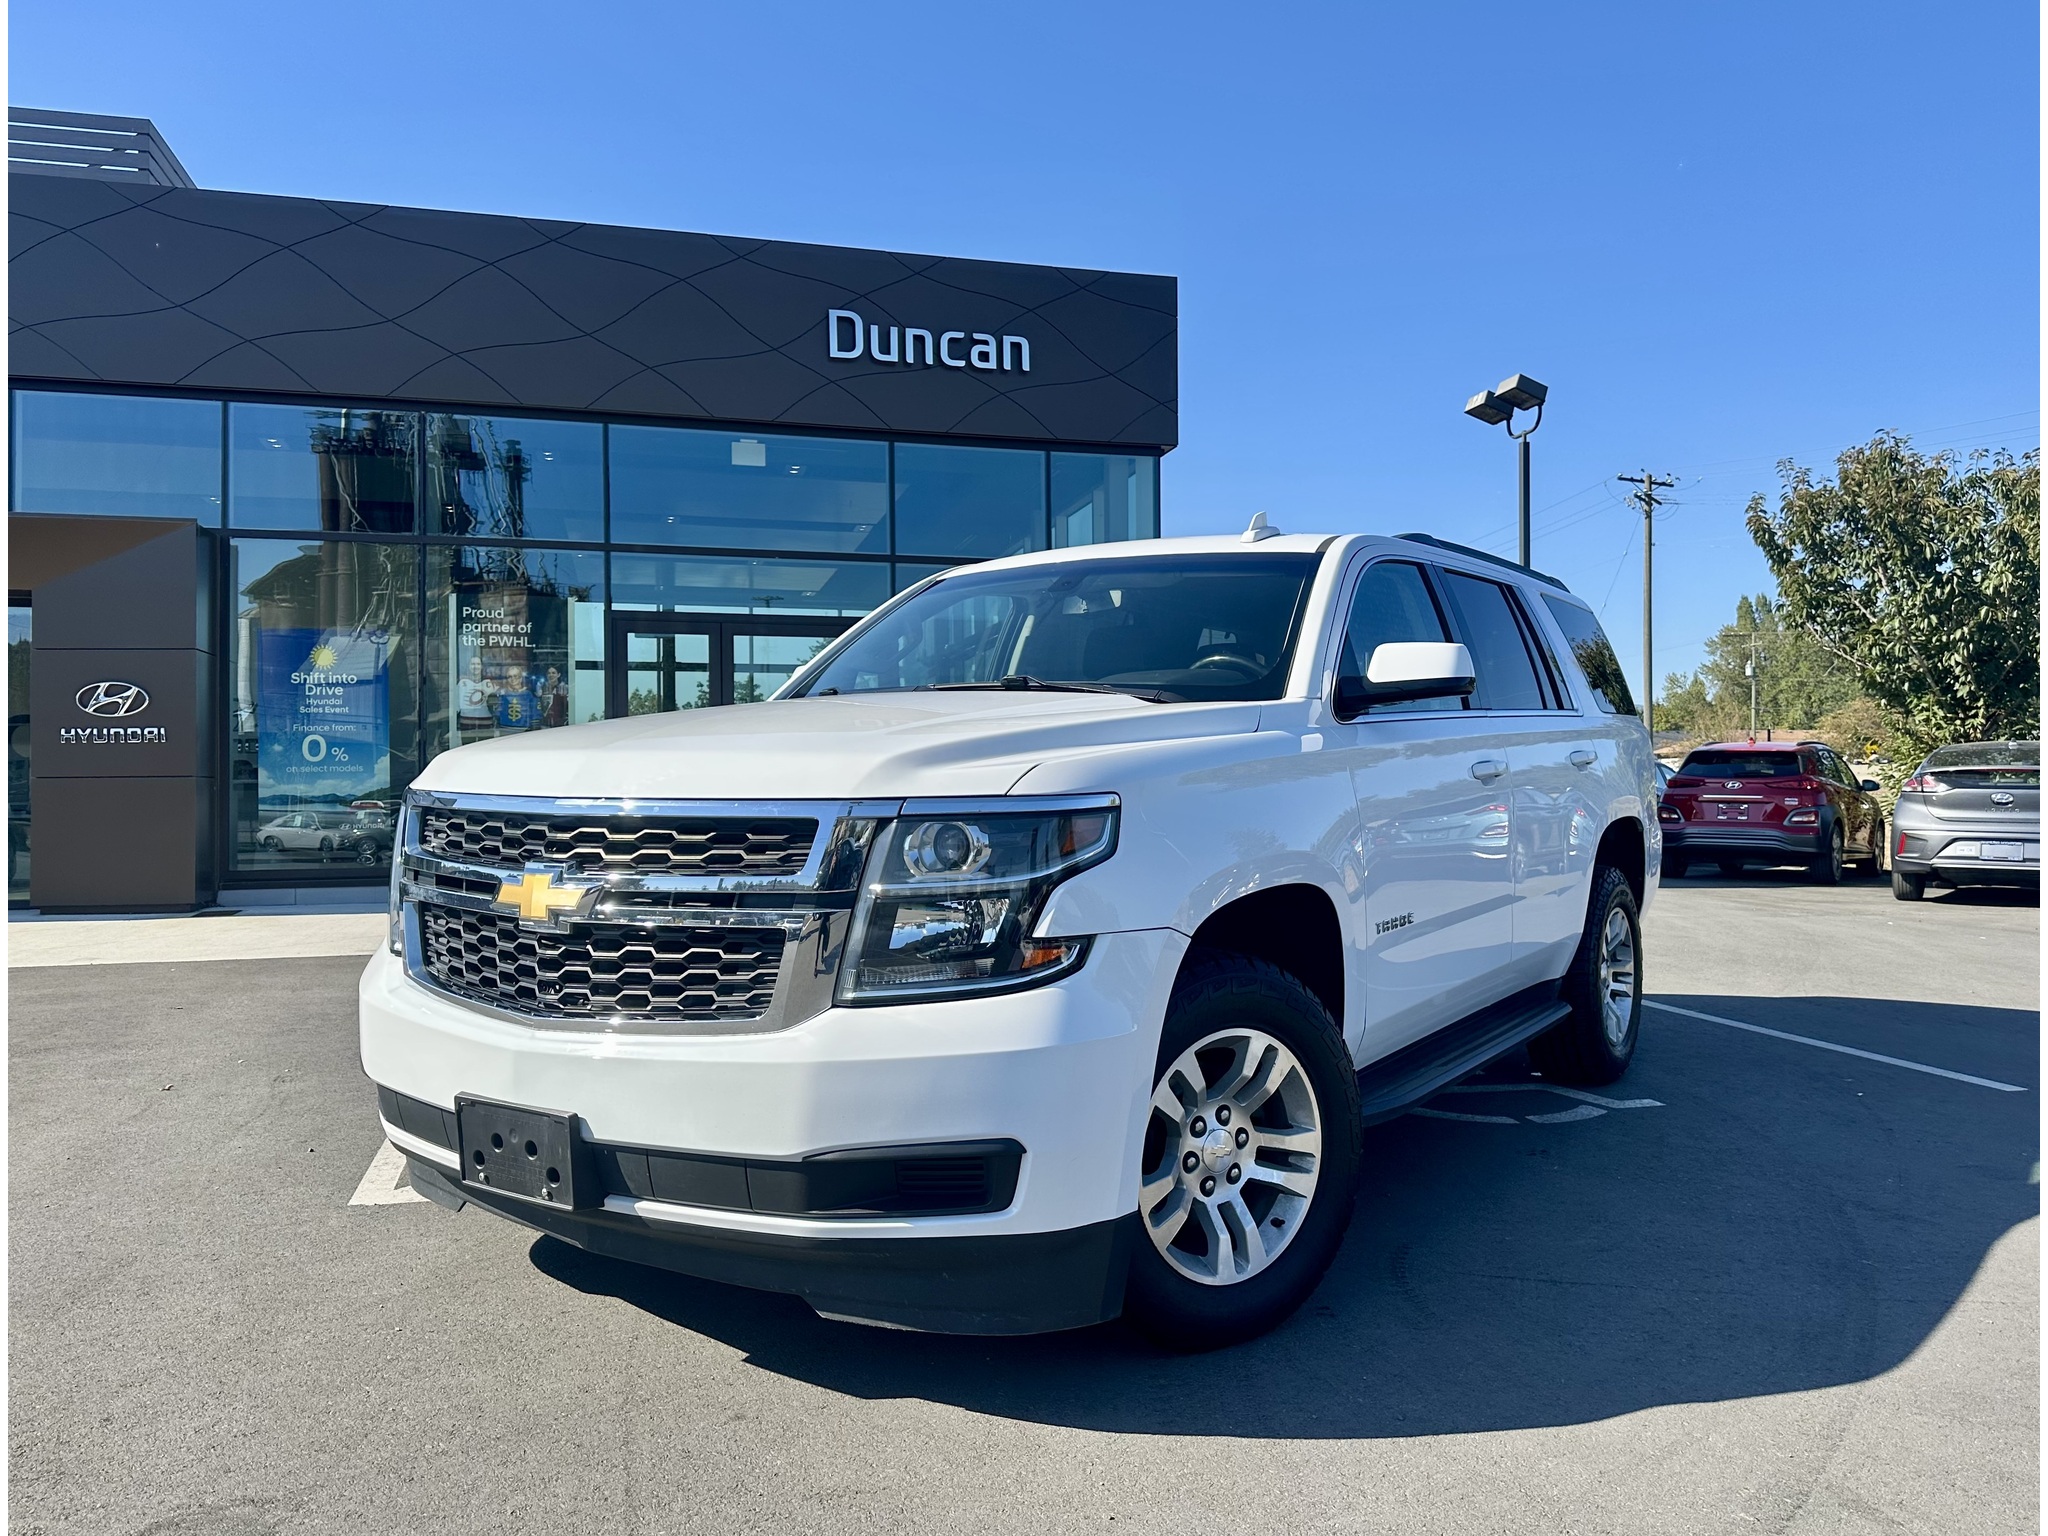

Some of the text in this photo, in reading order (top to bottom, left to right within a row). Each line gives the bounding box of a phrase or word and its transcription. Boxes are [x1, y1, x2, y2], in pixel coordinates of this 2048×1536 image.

[828, 308, 1030, 372] Duncan
[462, 606, 505, 619] Proud
[462, 621, 532, 634] partner of
[462, 635, 536, 648] the PWHL.
[290, 672, 358, 684] Shift into
[305, 684, 344, 696] Drive
[305, 698, 343, 706] Hyundai
[299, 706, 349, 714] Sales Event
[292, 723, 357, 732] Finance from:
[60, 727, 166, 744] HYUNDAI
[301, 734, 349, 763] 0 %
[286, 763, 364, 773] on select models
